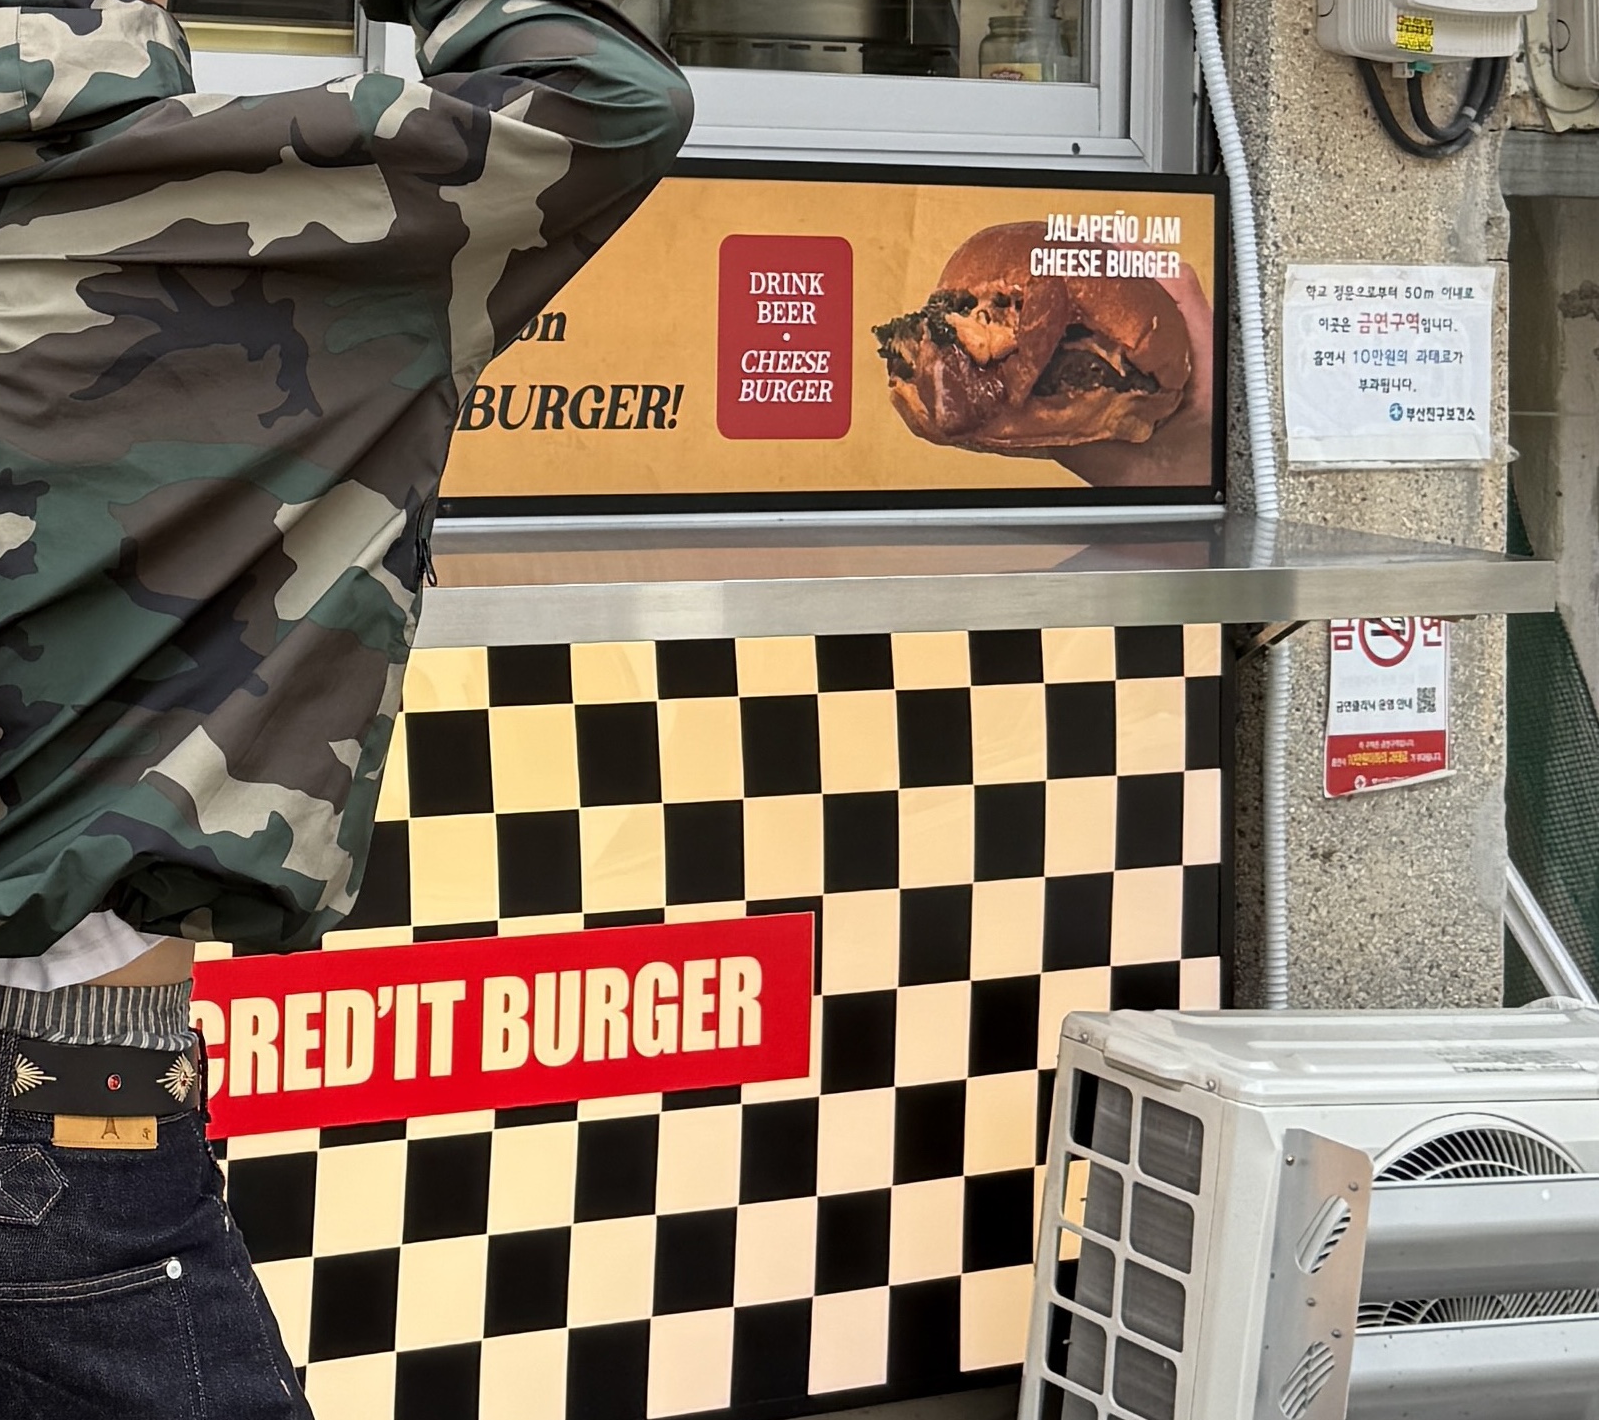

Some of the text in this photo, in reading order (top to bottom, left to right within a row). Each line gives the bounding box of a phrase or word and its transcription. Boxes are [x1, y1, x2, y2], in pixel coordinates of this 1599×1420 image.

[1045, 209, 1181, 246] JALAPEÑO JAM
[1030, 247, 1180, 280] CHEESE BURGER
[749, 270, 824, 297] DRINK
[1306, 285, 1328, 300] 학교
[1404, 286, 1434, 299] 50m
[757, 300, 817, 325] BEER
[1318, 317, 1352, 333] 이곳은
[741, 349, 830, 375] CHEESE
[1353, 348, 1408, 366] 10만원의
[738, 378, 833, 404] BURGER
[457, 383, 685, 432] BURGER!
[480, 954, 764, 1074] BURGER
